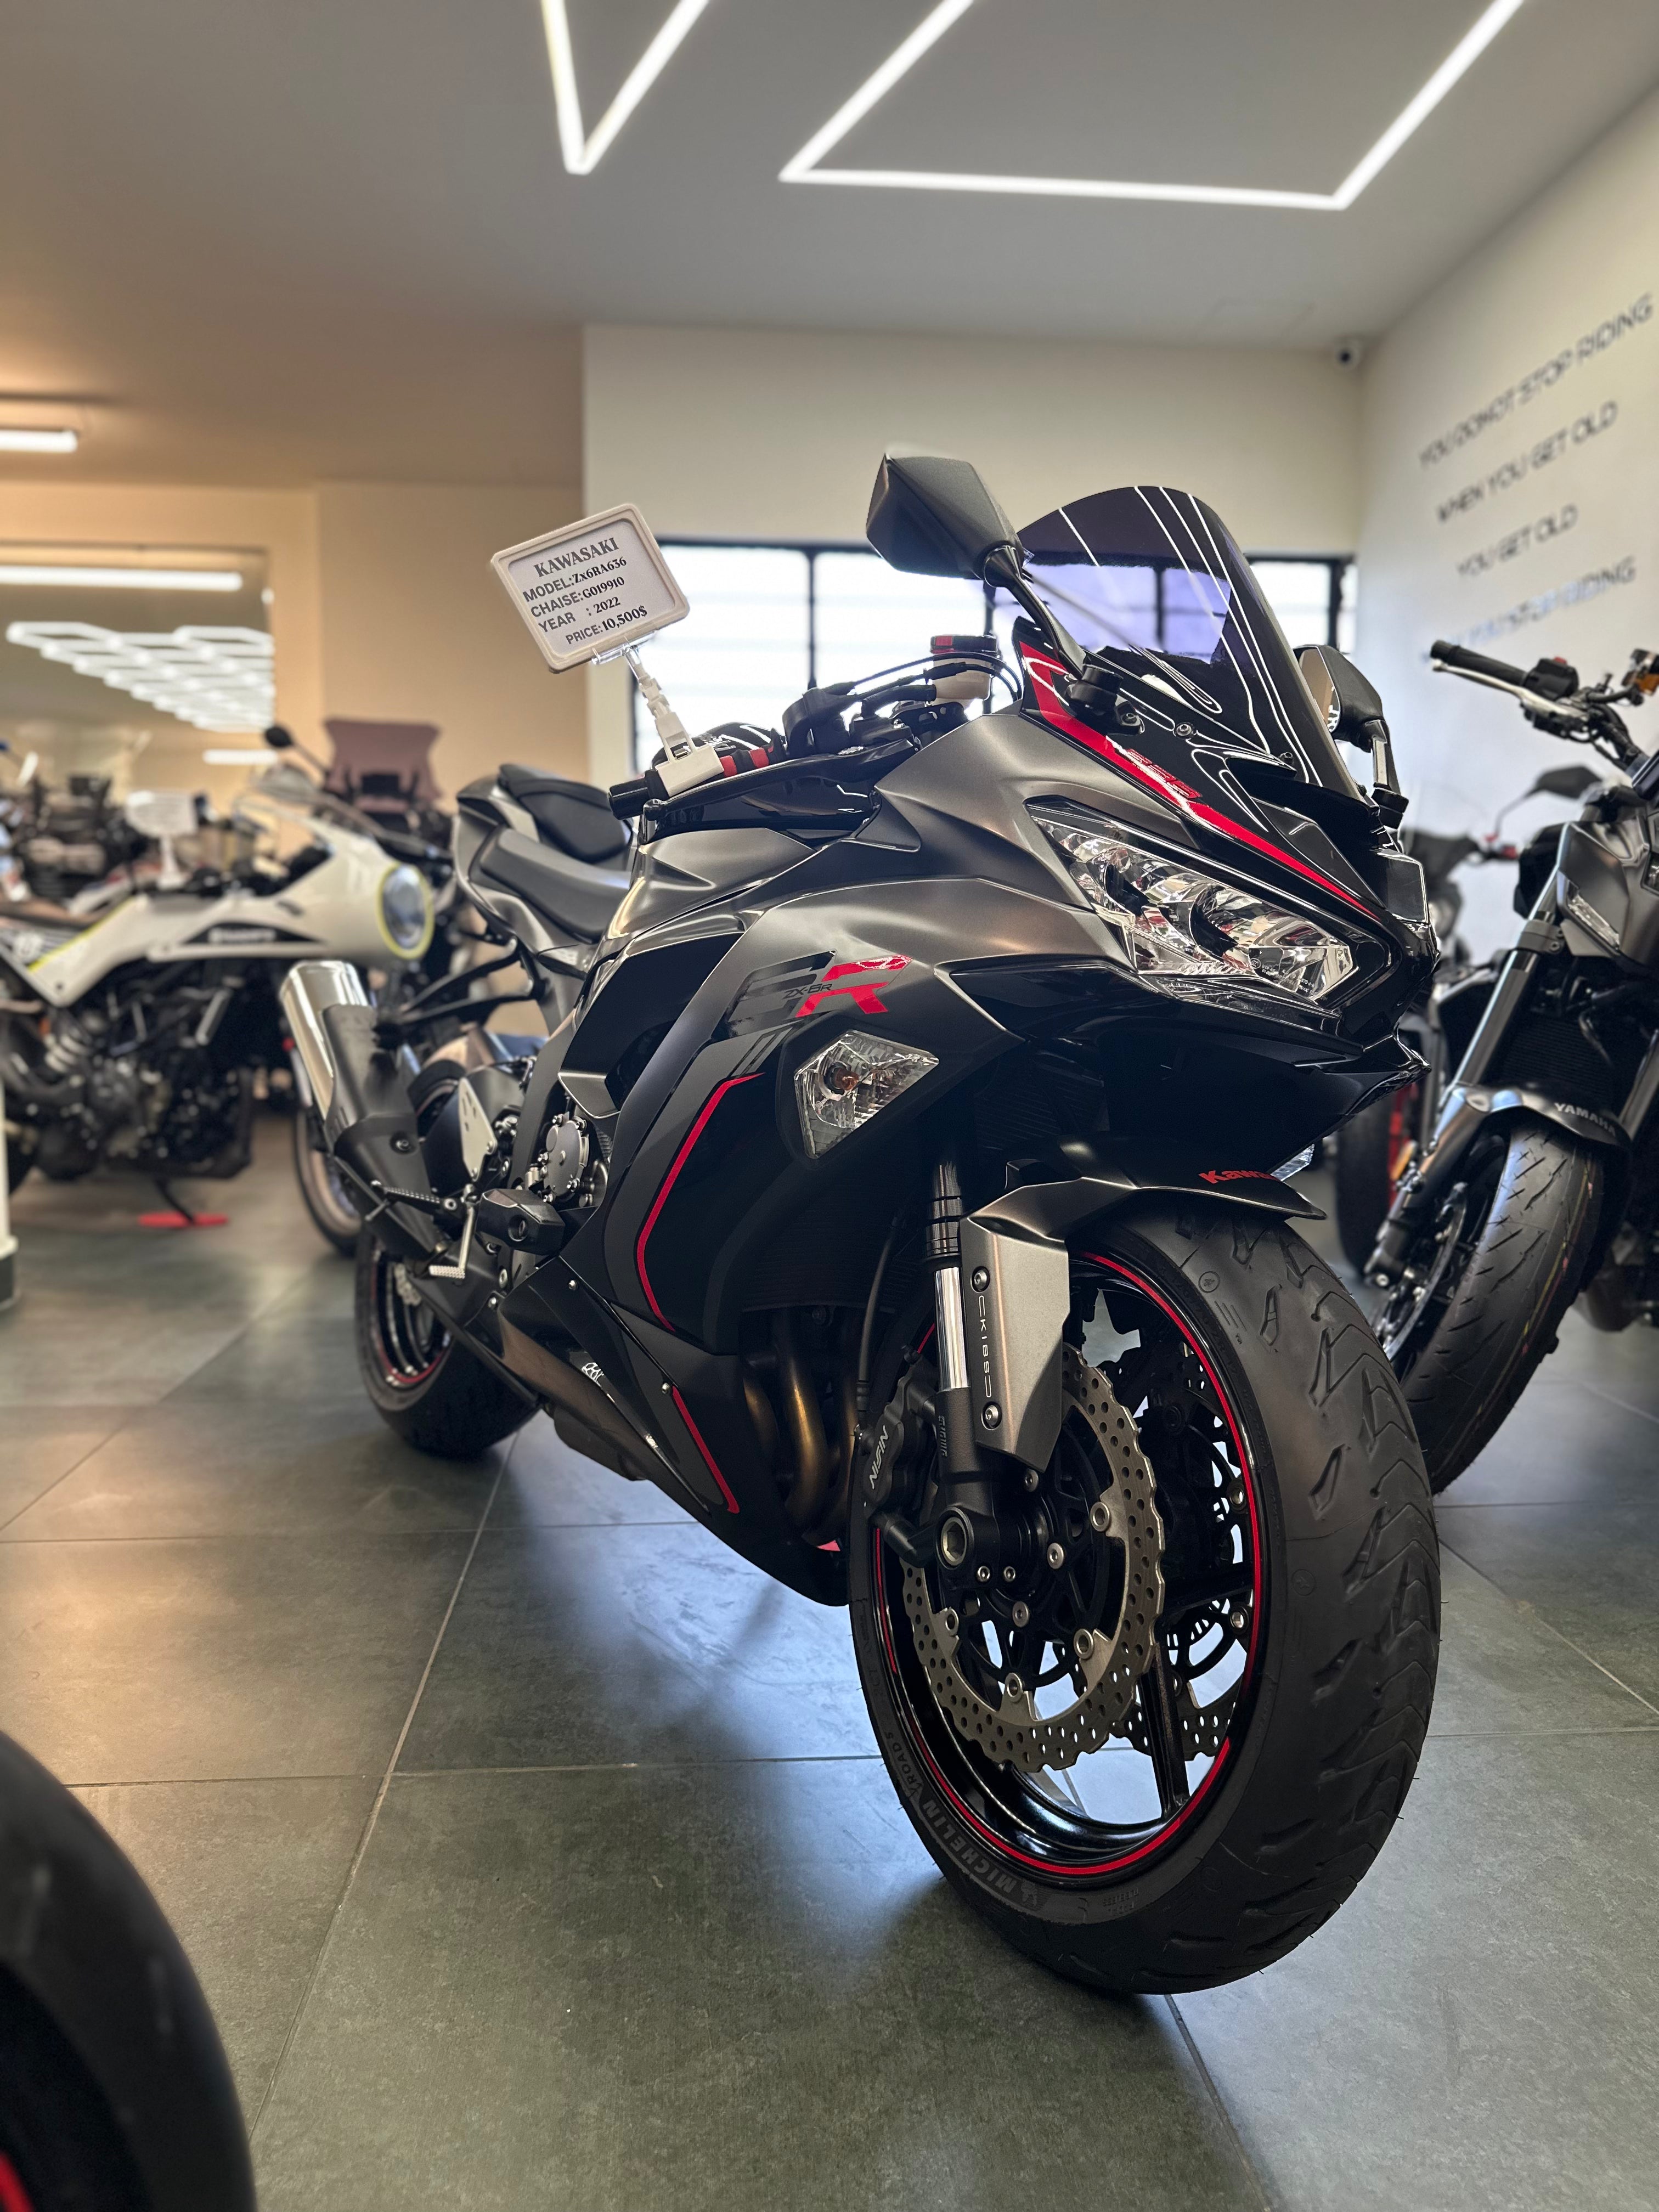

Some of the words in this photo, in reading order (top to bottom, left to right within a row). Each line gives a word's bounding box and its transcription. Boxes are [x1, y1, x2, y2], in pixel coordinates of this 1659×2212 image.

[1518, 349, 1572, 405] STOP
[1576, 292, 1653, 366] RIDING
[1437, 482, 1484, 523] WHEN
[1487, 453, 1527, 495] YOU
[1531, 428, 1568, 469] GET
[1572, 399, 1618, 445] OLD
[533, 537, 619, 577] KAWASAKI
[1456, 548, 1495, 578] YOU
[1498, 523, 1533, 563] GET
[1536, 503, 1578, 544] OLD
[538, 612, 575, 633] YEAR
[593, 596, 621, 614] 2022
[782, 984, 833, 1000] ZX-6R
[1554, 1103, 1616, 1136] YAMAHA
[869, 1425, 888, 1489] NISSIN
[886, 1731, 894, 1740] 5
[892, 1741, 918, 1786] ROAD
[922, 1799, 1018, 1894] MICHELIN
